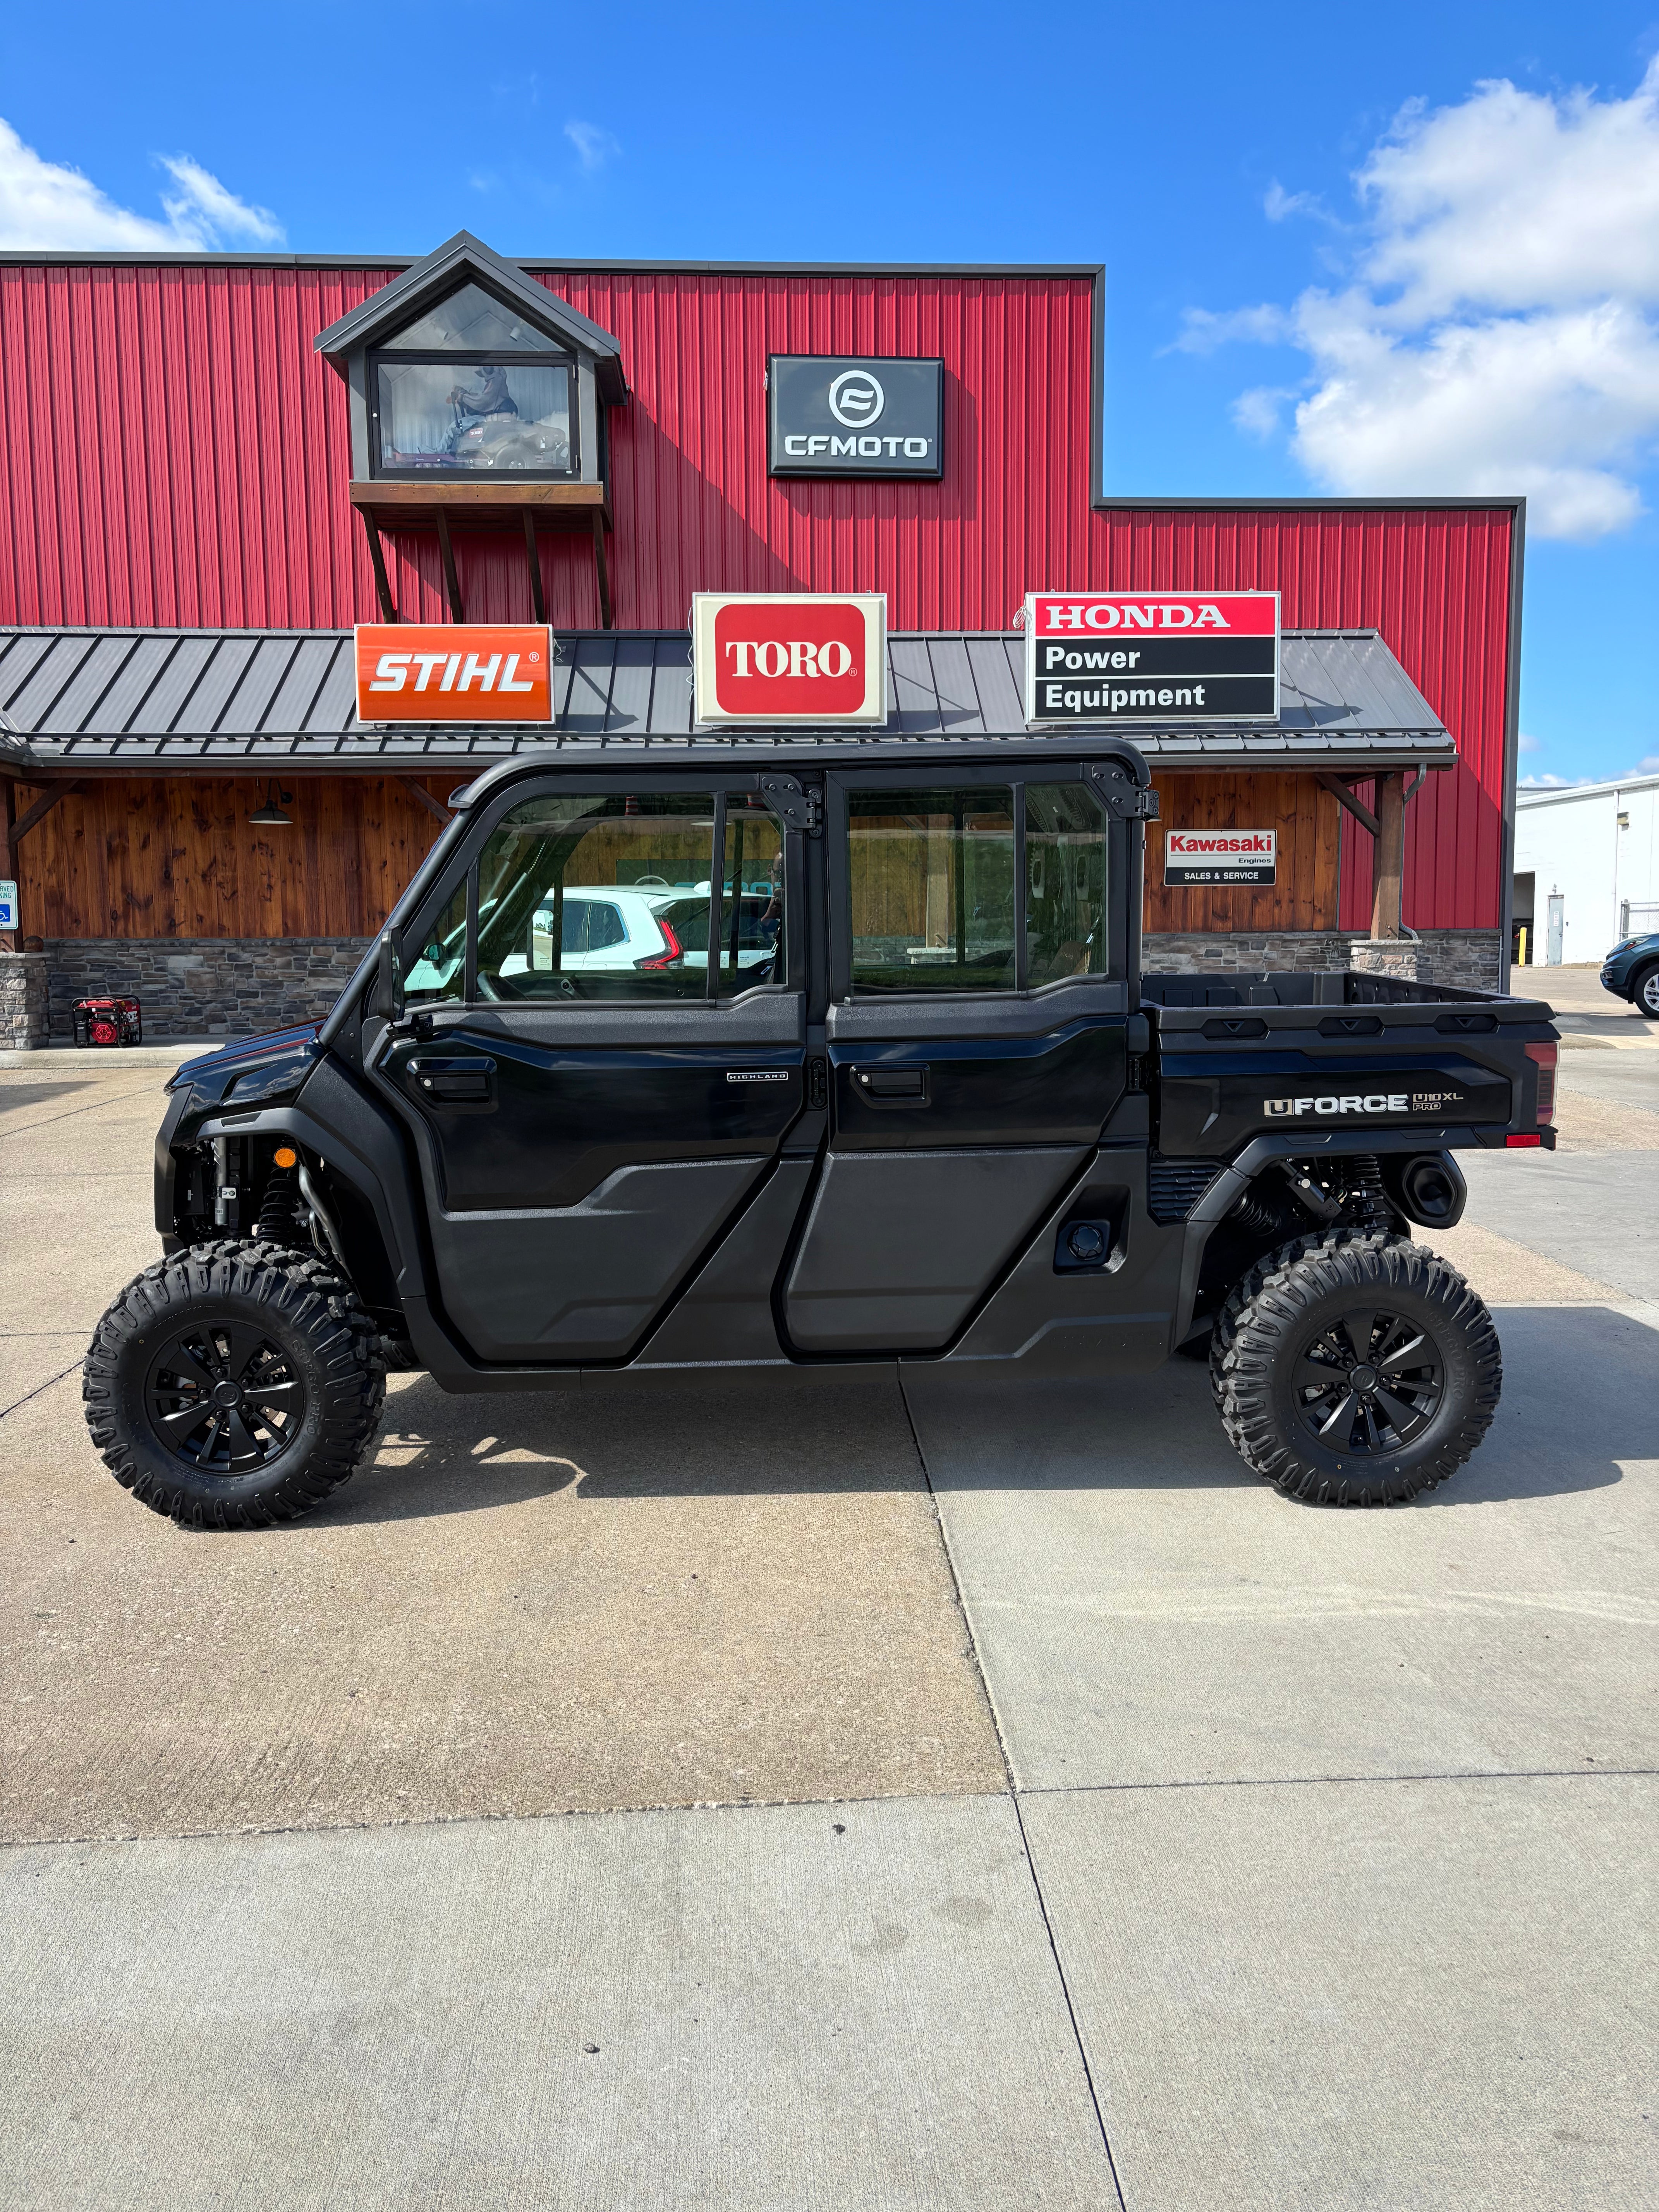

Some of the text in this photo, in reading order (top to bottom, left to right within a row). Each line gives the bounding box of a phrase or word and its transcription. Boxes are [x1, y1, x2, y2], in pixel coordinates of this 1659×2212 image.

[785, 435, 927, 457] CFMOTO
[1046, 605, 1231, 629] HONDA
[726, 641, 852, 678] TORO
[1046, 646, 1140, 669] Power
[369, 653, 533, 692] STIHL
[1046, 684, 1205, 712] Equipment
[1171, 835, 1271, 852] Kawasaki
[1413, 1102, 1441, 1111] PRO
